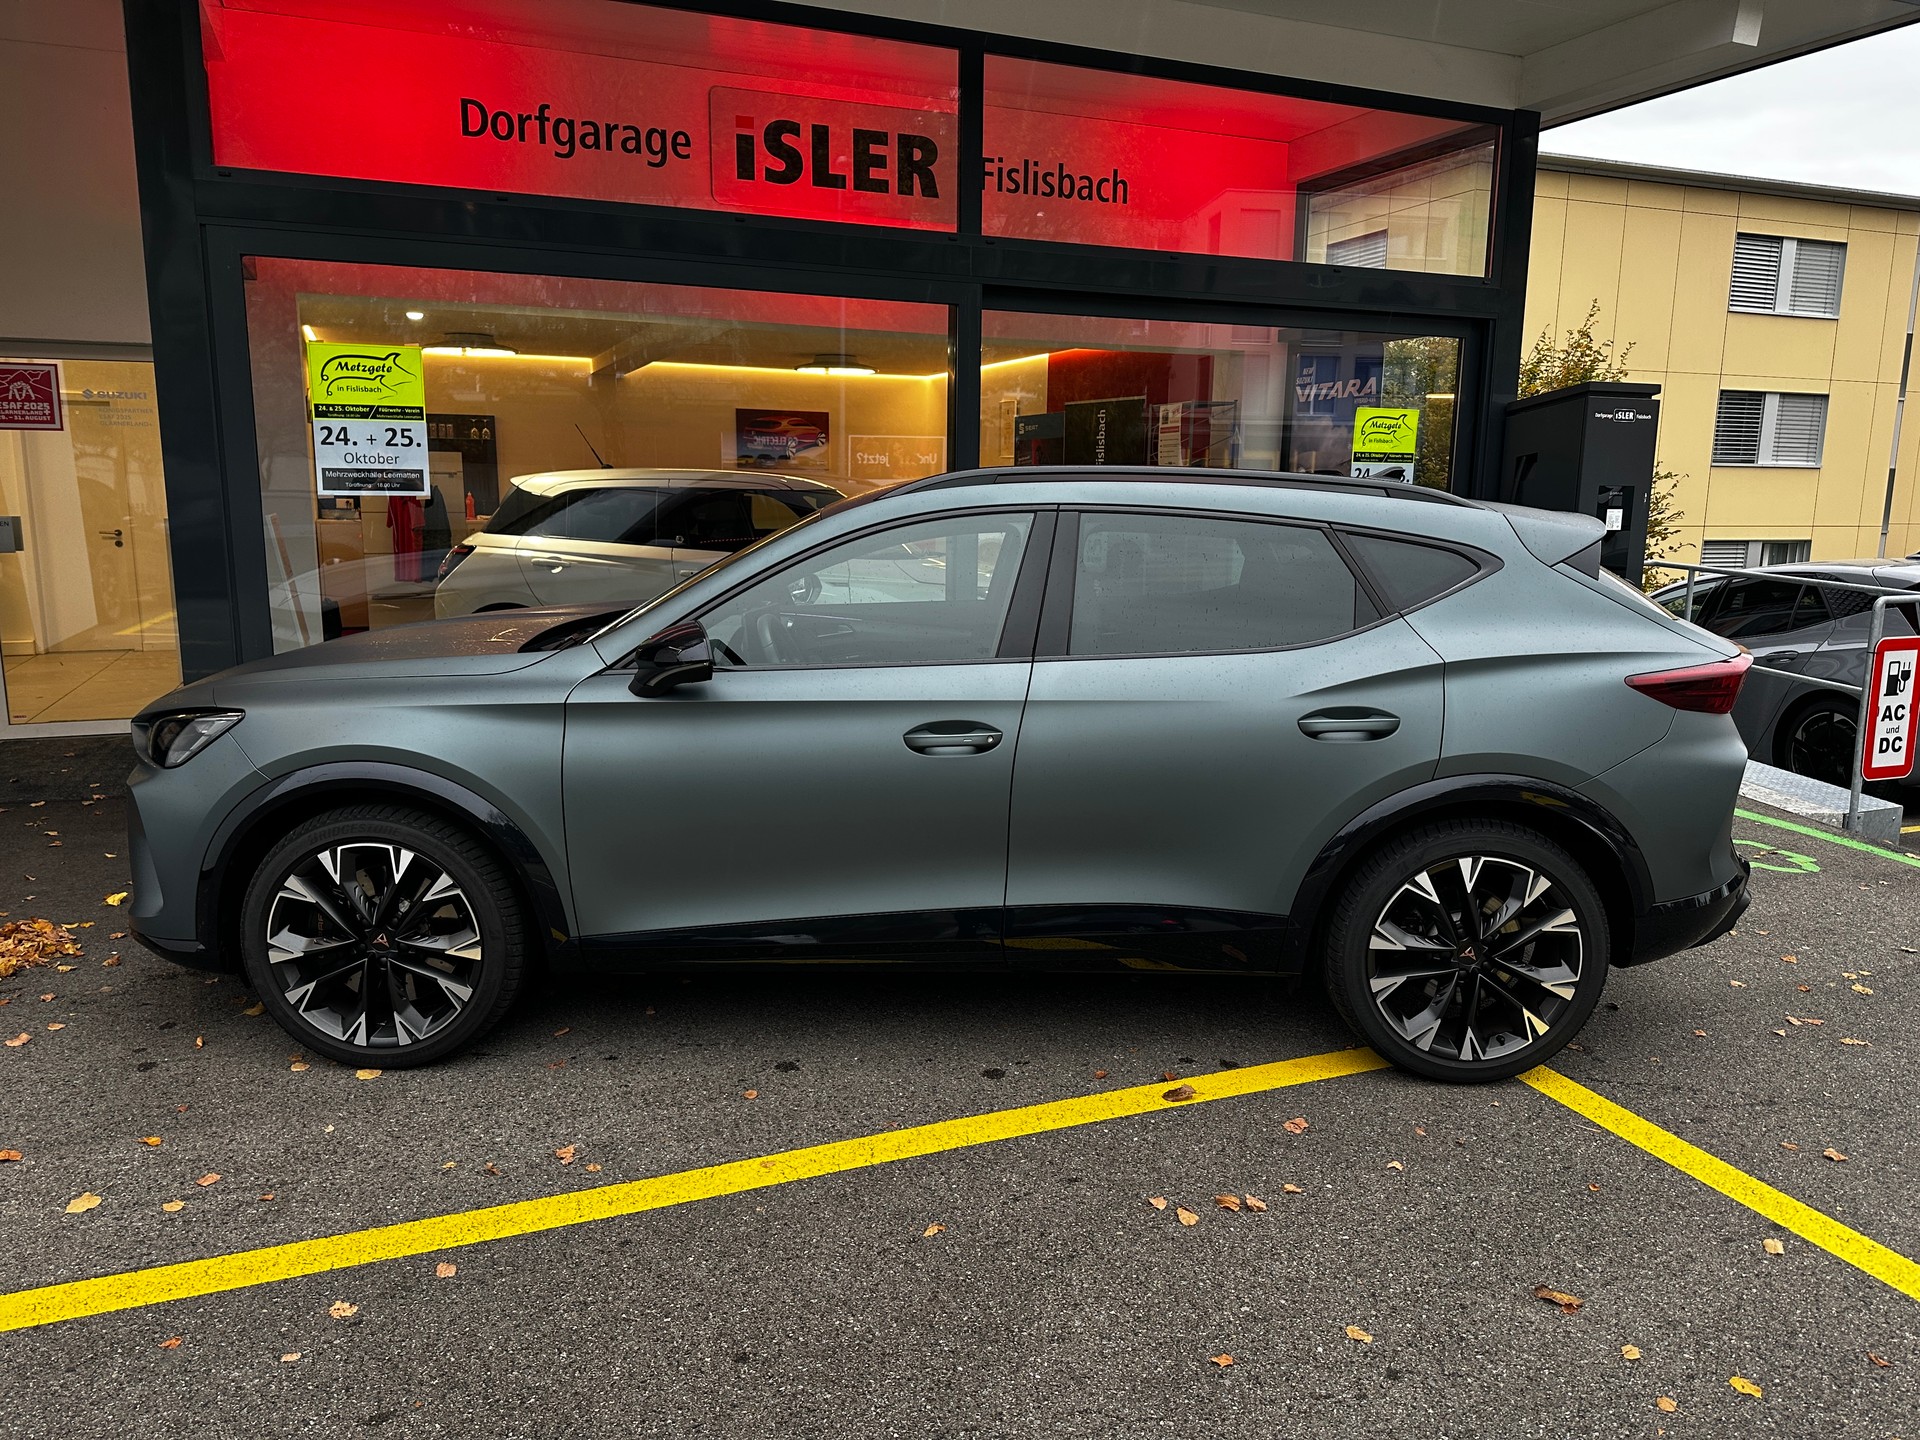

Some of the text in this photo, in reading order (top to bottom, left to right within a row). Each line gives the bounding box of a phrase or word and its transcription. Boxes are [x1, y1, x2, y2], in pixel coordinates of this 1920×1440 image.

[460, 97, 1128, 205] Dorfgarage iSLER Fislisbach
[335, 361, 393, 375] Metzgete
[97, 391, 147, 400] SUZUKI
[1296, 377, 1377, 402] VITARA
[320, 426, 421, 447] 24. + 25.
[1096, 410, 1106, 465] islisbach
[344, 452, 400, 464] Oktober
[1881, 704, 1906, 722] AC
[1886, 725, 1900, 734] und
[1878, 736, 1903, 754] DC
